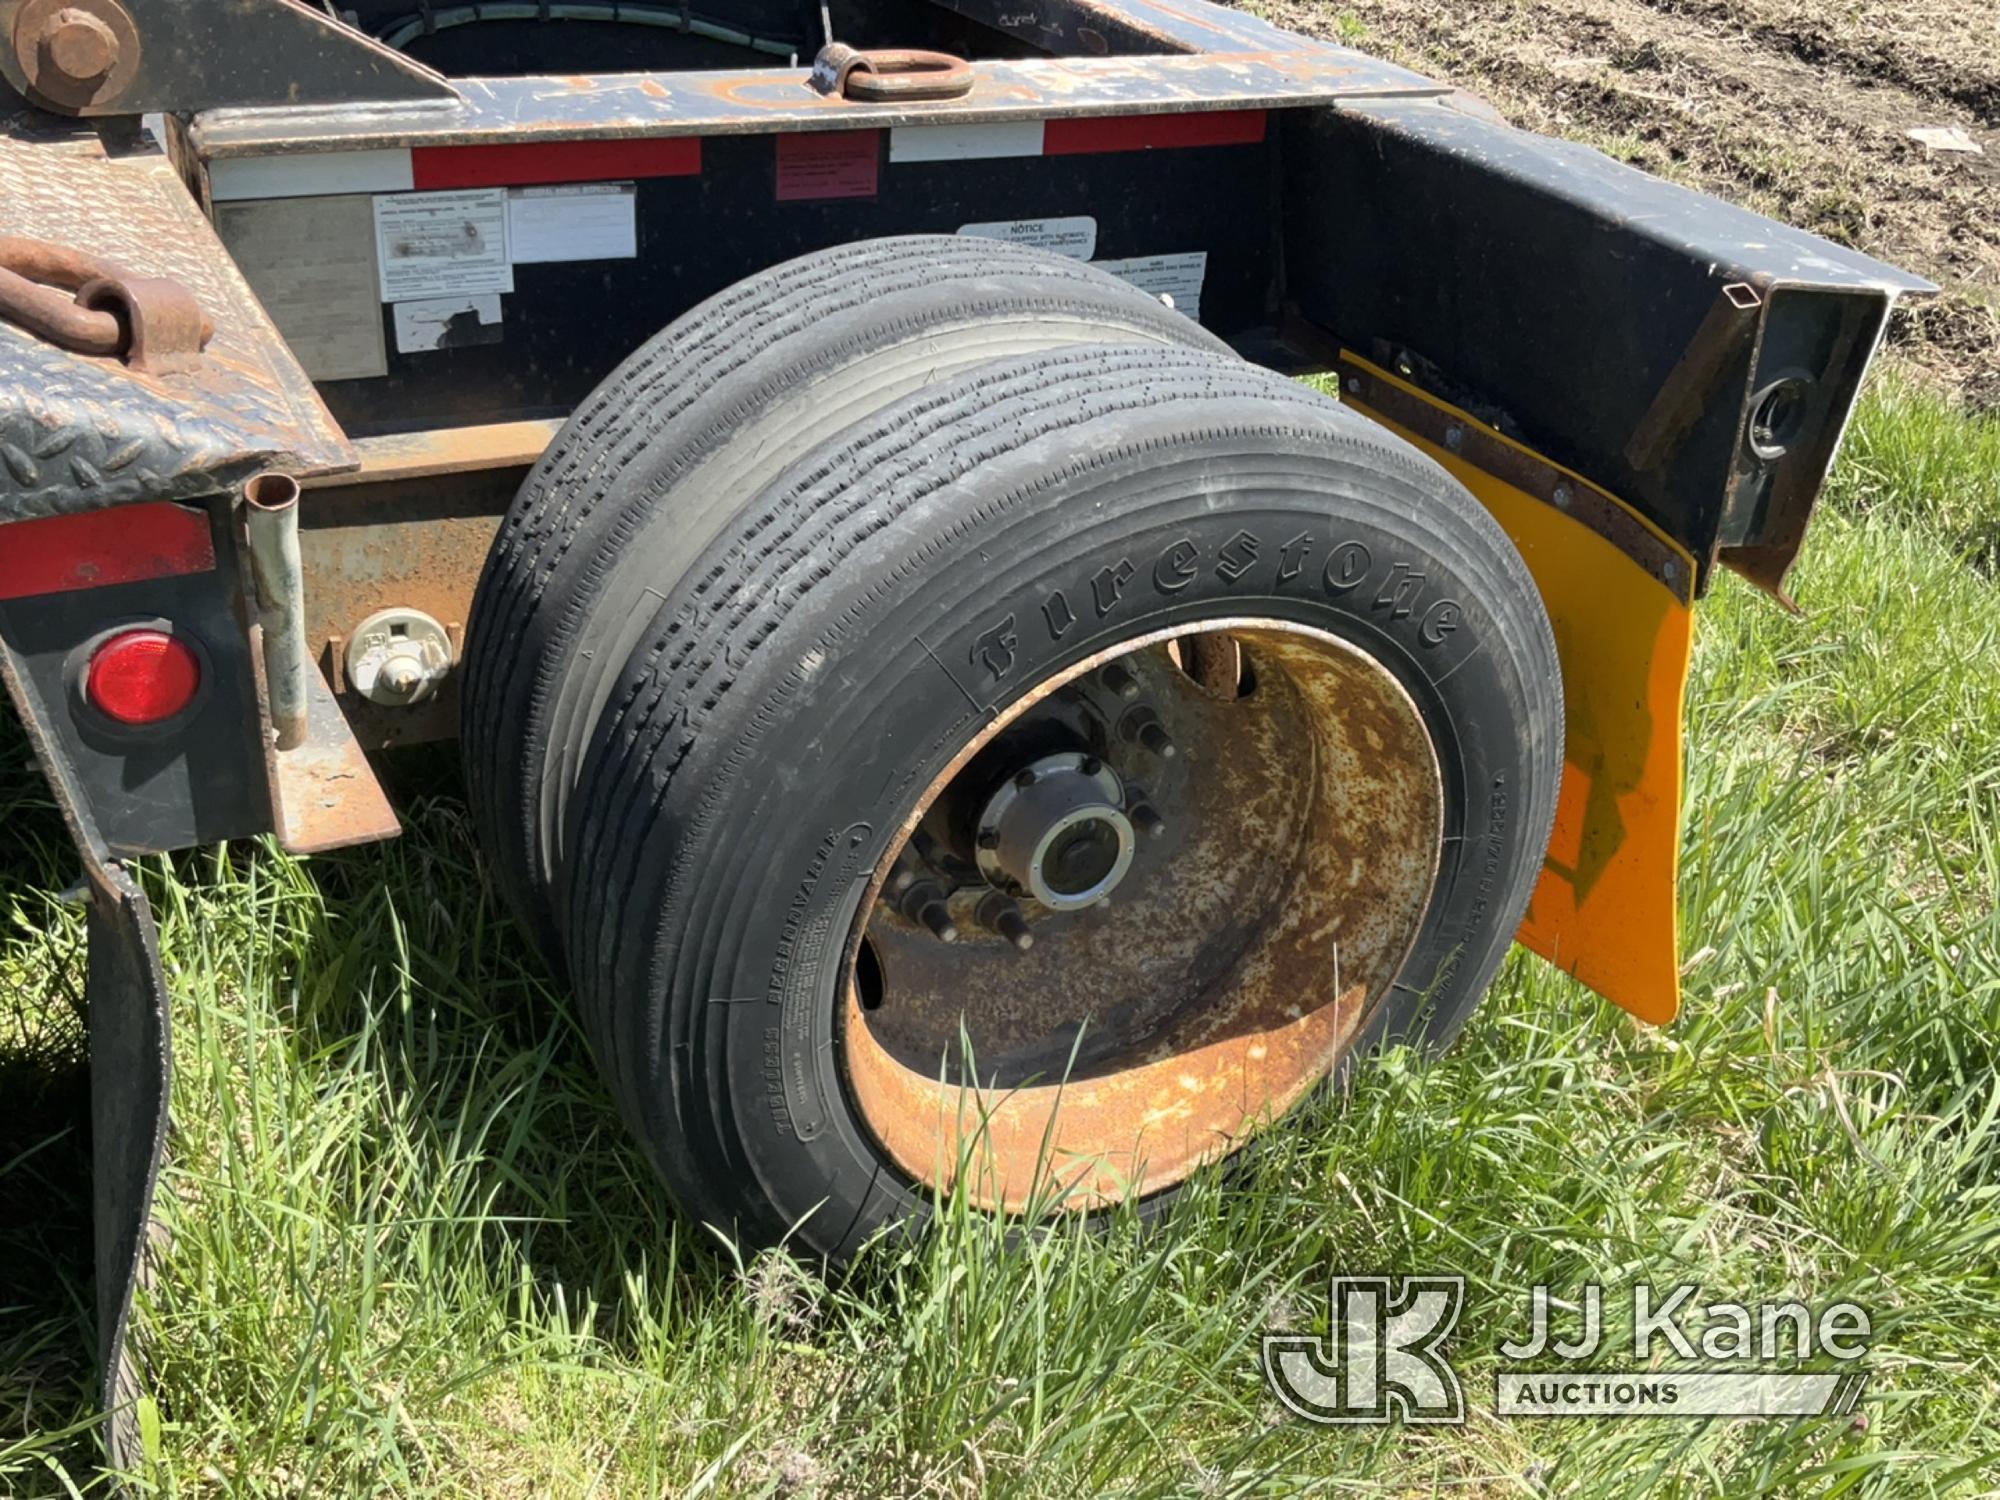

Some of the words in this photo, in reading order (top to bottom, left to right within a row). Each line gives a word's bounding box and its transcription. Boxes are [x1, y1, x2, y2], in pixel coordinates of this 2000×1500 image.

[1010, 223, 1044, 235] NOTICE
[969, 528, 1463, 681] Firestone
[767, 828, 840, 1005] REGROOVABLE
